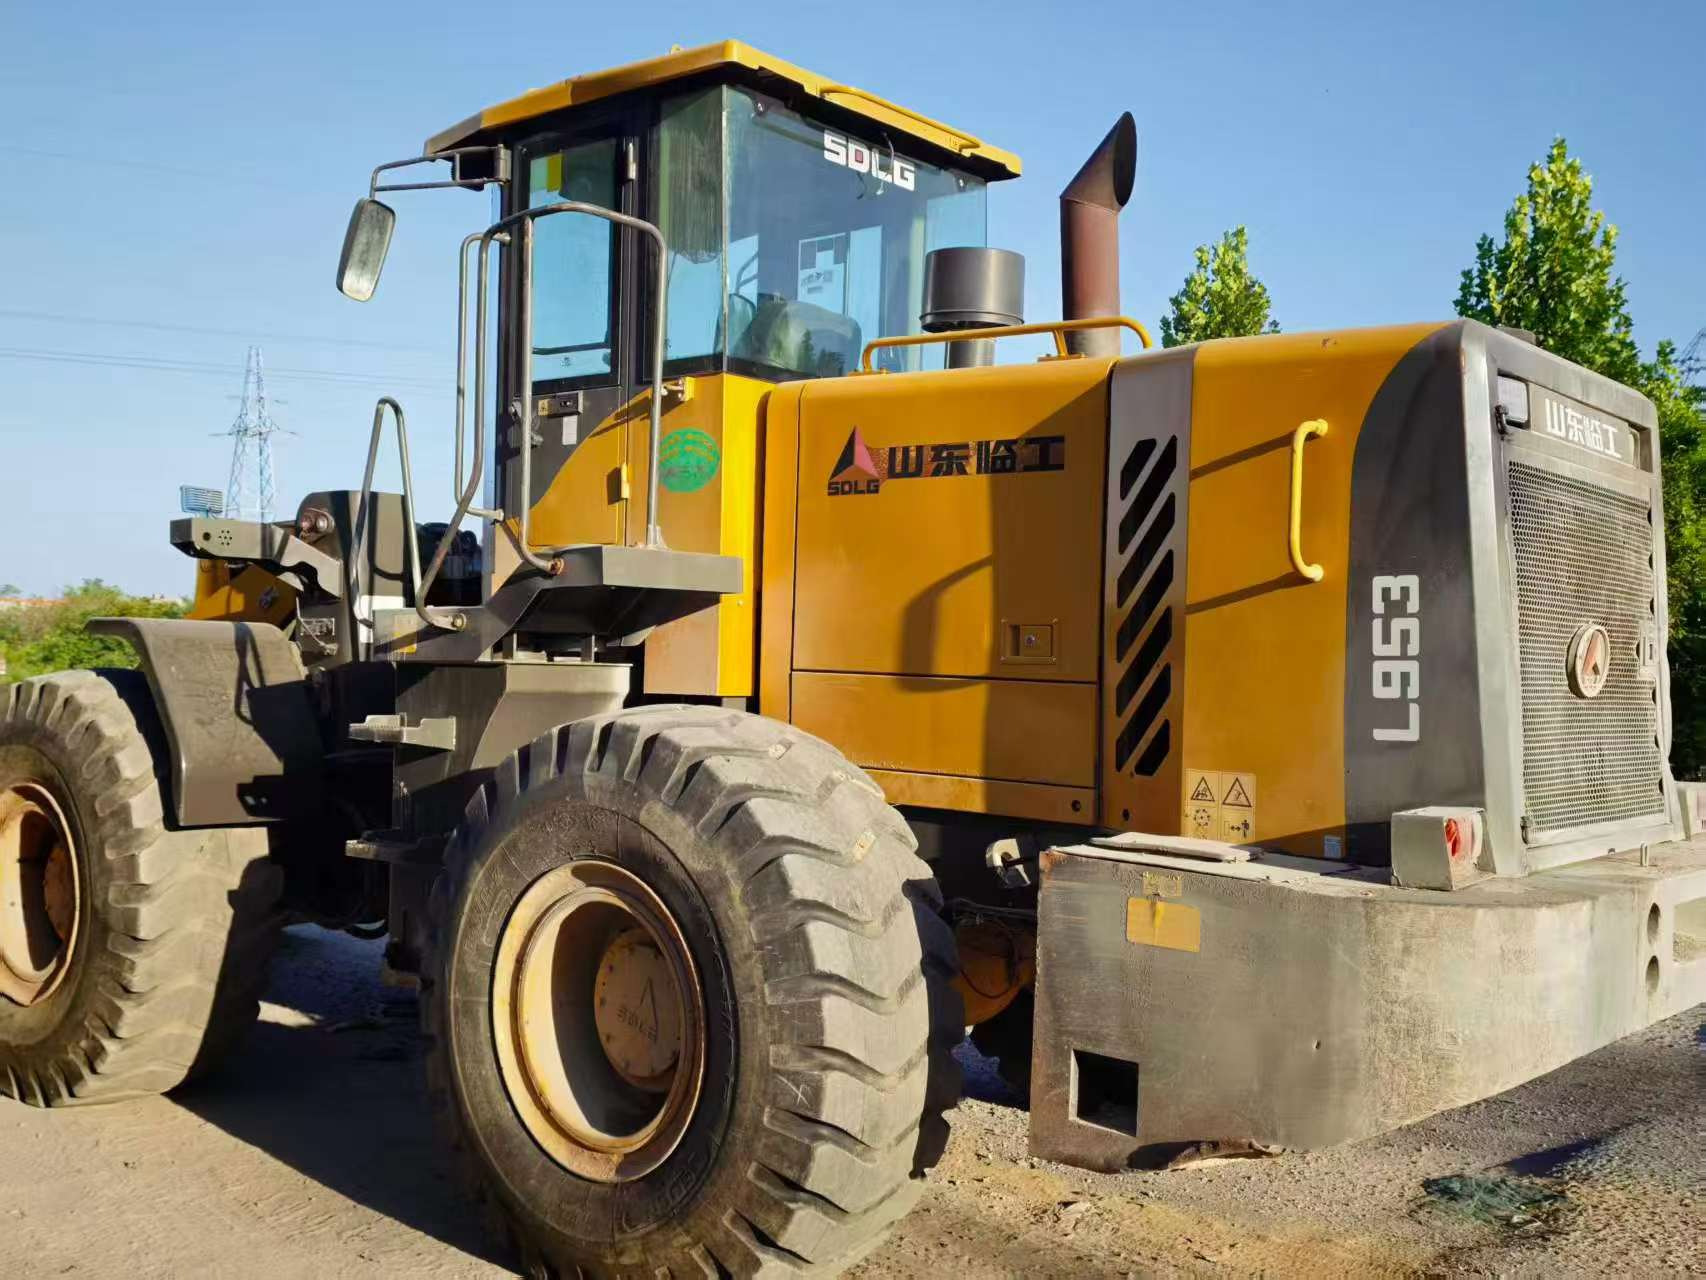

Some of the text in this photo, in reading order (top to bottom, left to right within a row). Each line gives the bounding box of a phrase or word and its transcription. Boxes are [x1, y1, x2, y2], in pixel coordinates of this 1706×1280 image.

[824, 130, 915, 191] SDLG
[888, 435, 1065, 479] 山东临工
[1545, 398, 1622, 458] 山东临工
[828, 479, 880, 496] SDLG
[1372, 575, 1420, 741] L953
